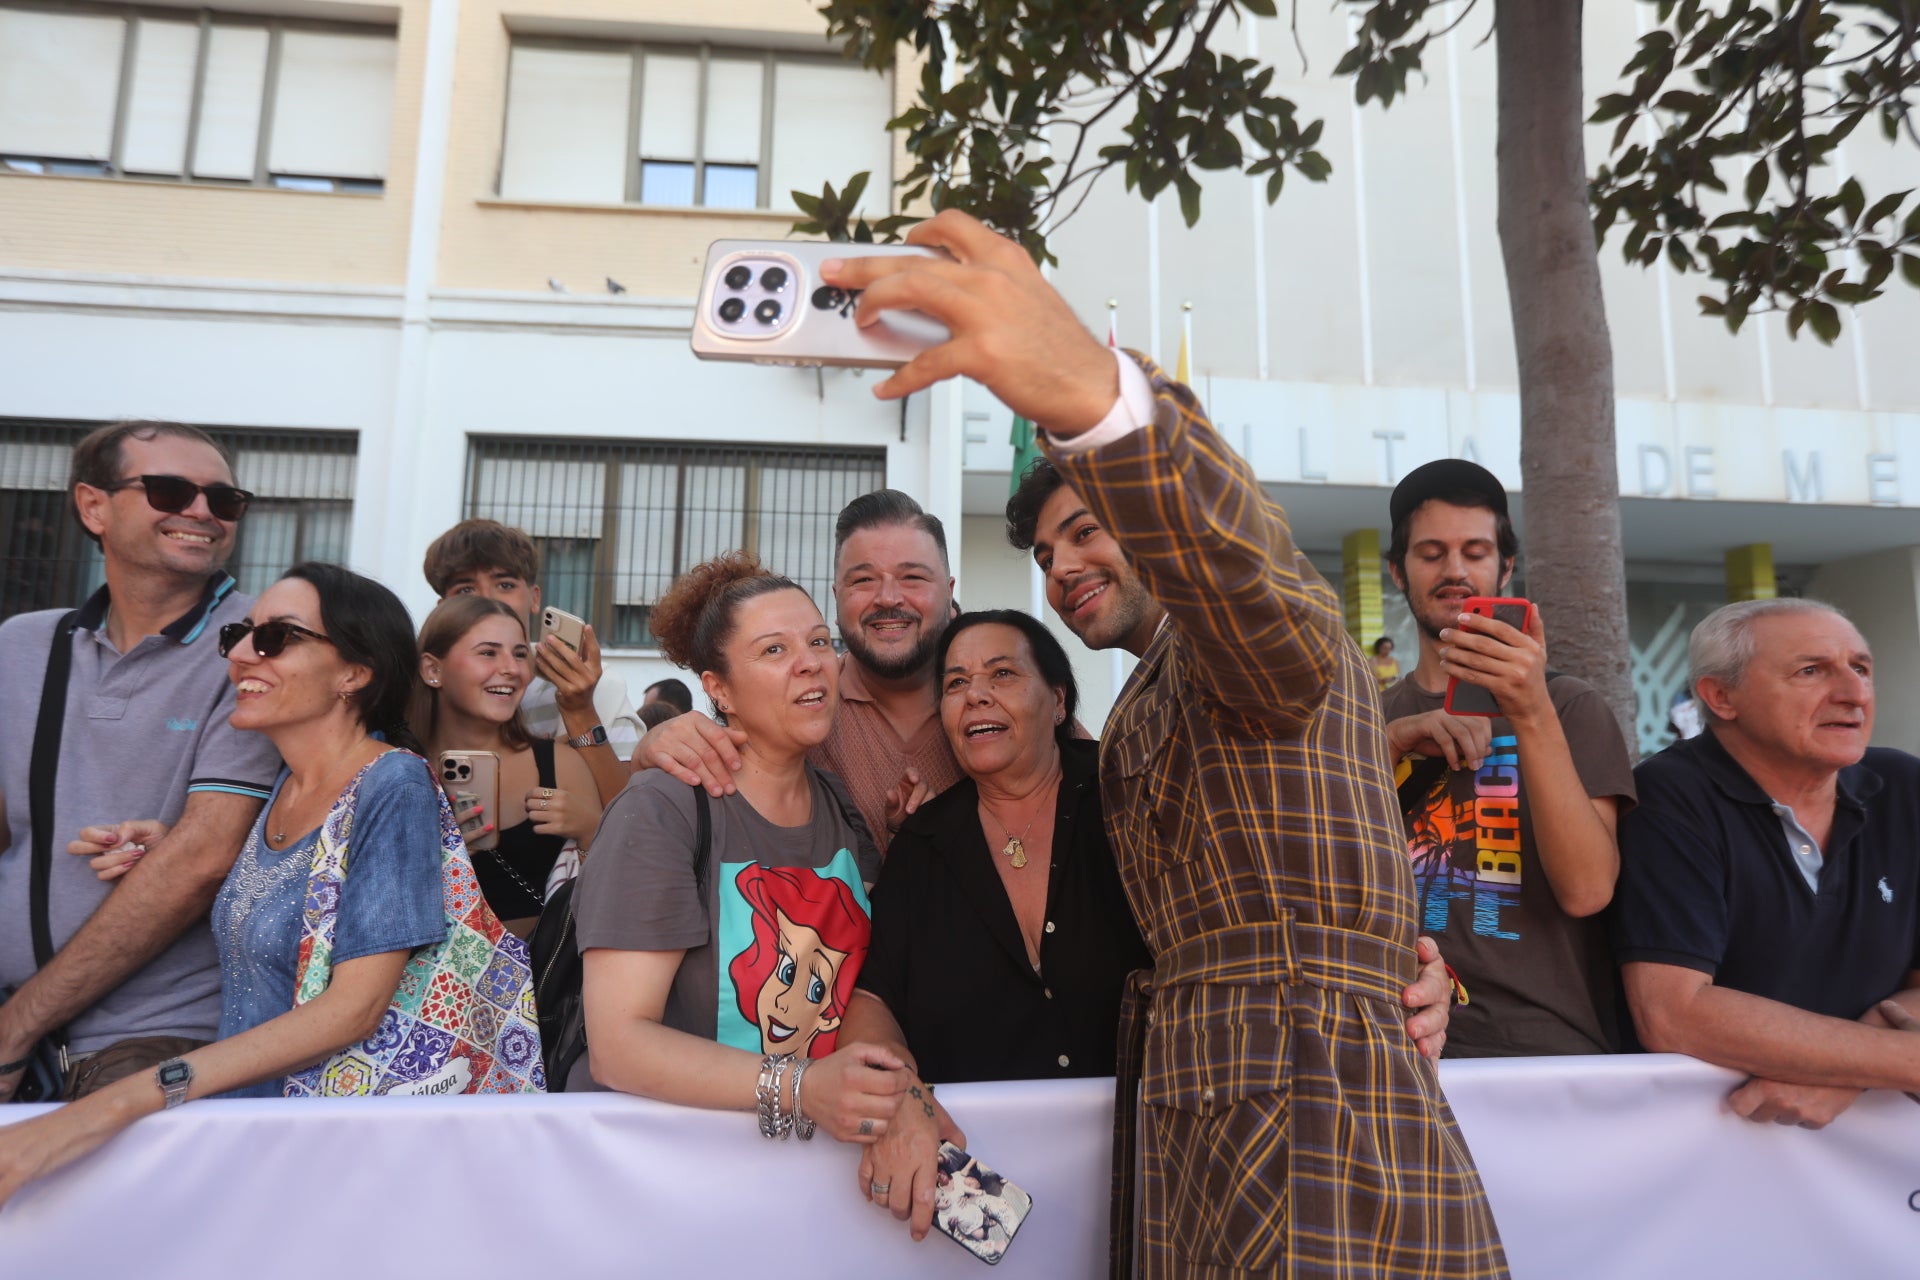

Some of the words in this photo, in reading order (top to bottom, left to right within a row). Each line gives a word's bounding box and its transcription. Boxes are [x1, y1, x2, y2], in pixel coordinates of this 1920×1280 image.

[1637, 442, 1717, 498] DE
[1473, 735, 1522, 885] BEACH
[411, 1074, 457, 1096] álaga
